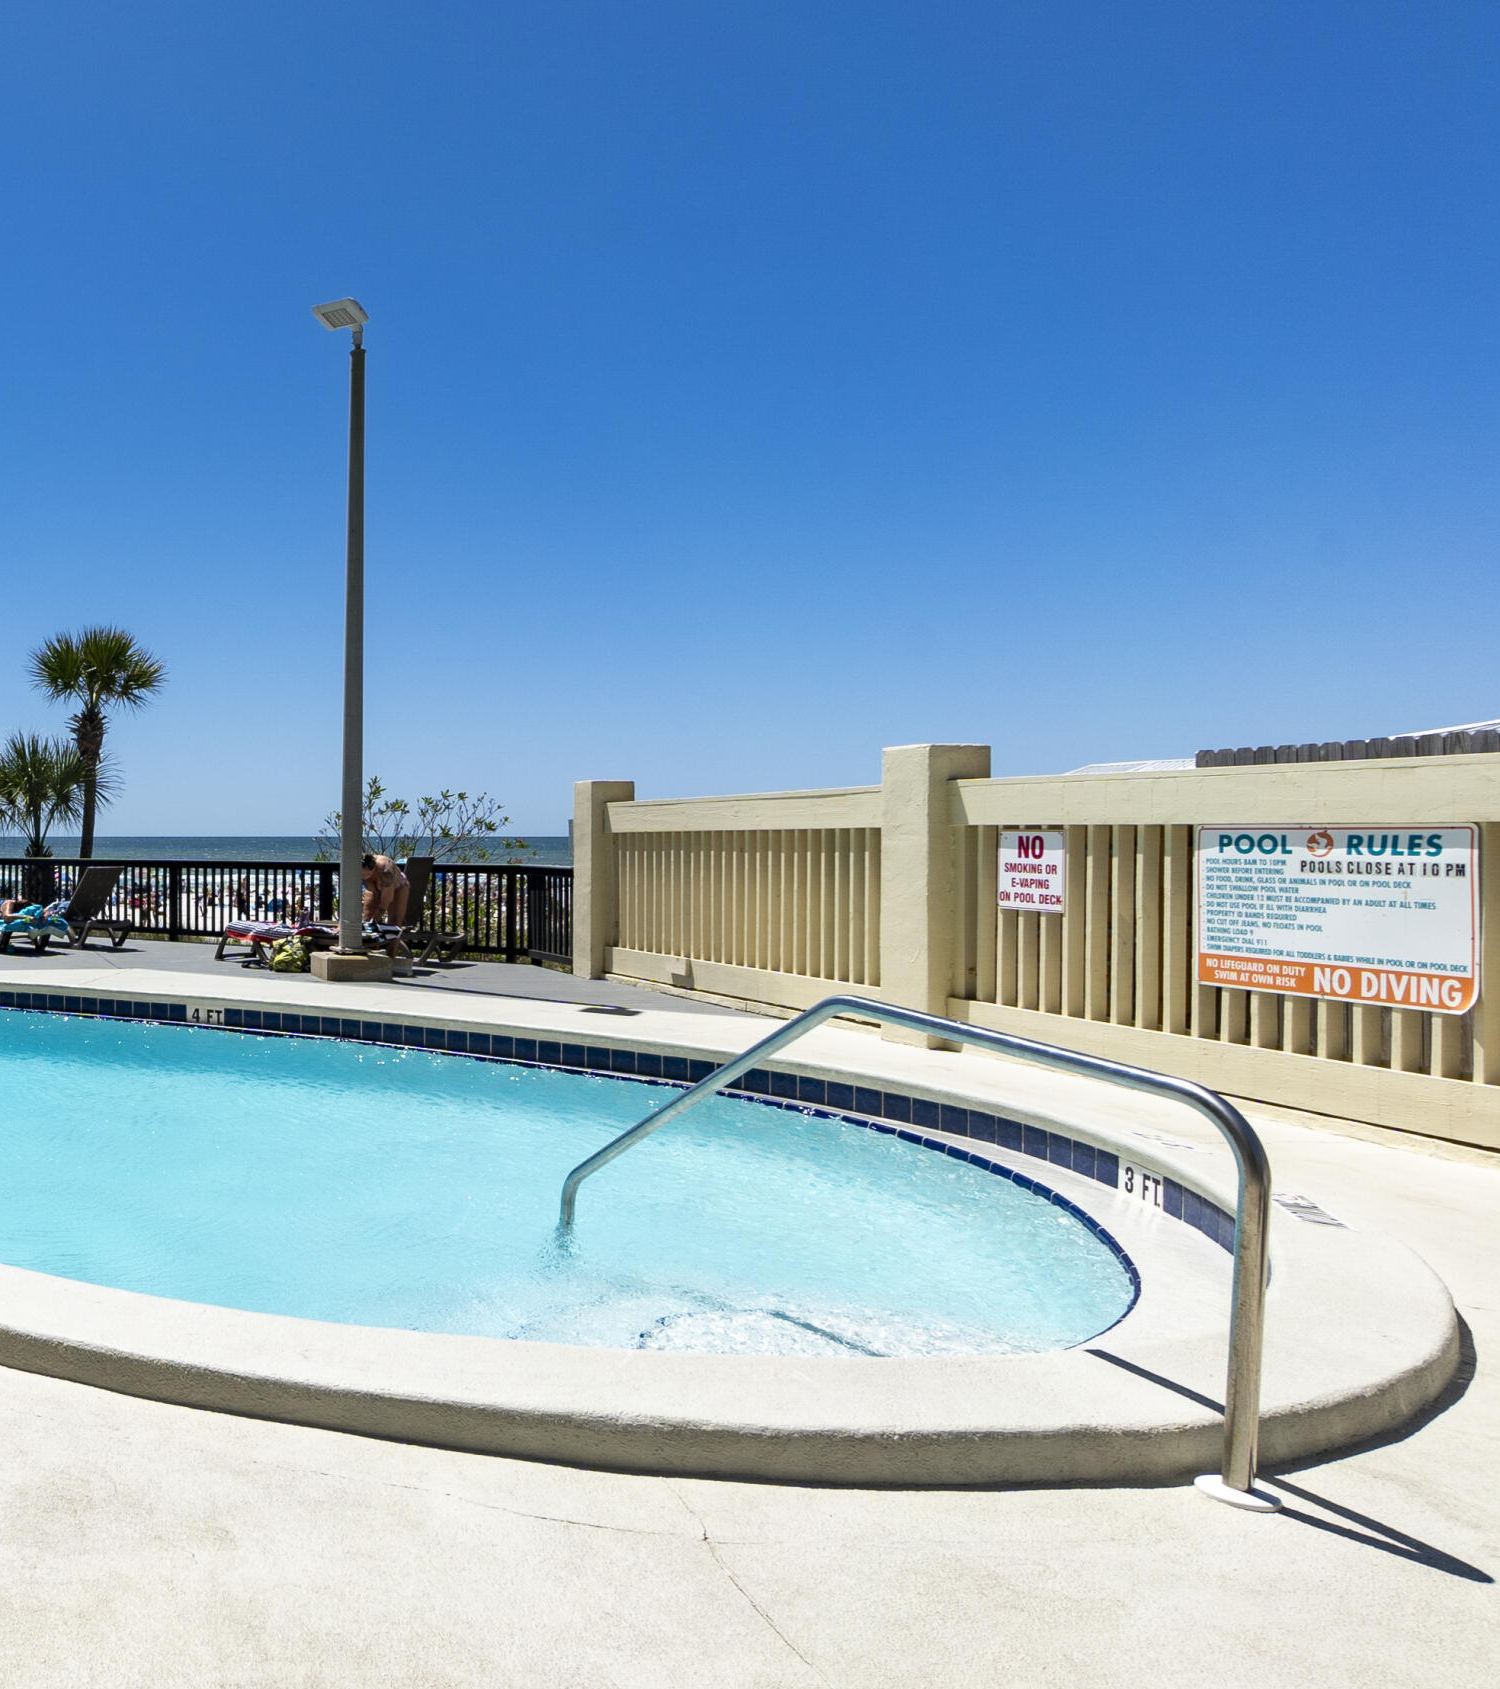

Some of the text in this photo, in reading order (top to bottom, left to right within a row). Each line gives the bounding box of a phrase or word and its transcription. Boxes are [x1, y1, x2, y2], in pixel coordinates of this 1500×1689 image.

[1018, 835, 1044, 859] NO
[1219, 834, 1443, 856] POOL RULES
[1004, 863, 1057, 875] SMOKING OR
[1300, 860, 1466, 877] POOLS CLOSE AT 10 PM
[1011, 877, 1049, 889] E-VAPING
[1229, 884, 1258, 892] SWALLOW
[1260, 885, 1276, 893] POOL
[1279, 886, 1299, 894] WATER
[1319, 878, 1326, 886] IN
[1328, 879, 1345, 887] POOL
[1371, 880, 1391, 888] POOL
[1393, 881, 1411, 889] DECK
[1000, 891, 1062, 905] ON POOL DECK
[1235, 893, 1254, 901] UNDER
[1285, 895, 1292, 903] BE
[1294, 896, 1340, 905] ACCOMPANIED
[1342, 898, 1350, 906] BY
[1365, 899, 1386, 908] ADULT
[1388, 900, 1397, 908] AT
[1399, 901, 1412, 909] ALL
[1414, 901, 1436, 910] TIMES
[1207, 909, 1235, 917] PROPERTY
[1245, 911, 1265, 919] BANDS
[1266, 912, 1297, 921] REQUIRED
[1242, 902, 1257, 910] POOL
[1295, 905, 1327, 914] DIARRHEA
[1207, 926, 1231, 935] BATHING
[1273, 922, 1295, 930] FLOATS
[1306, 924, 1323, 932] POOL
[1207, 935, 1240, 944] EMERGENCY
[1223, 944, 1244, 953] DIAPERS
[1245, 946, 1272, 955] REQUIRED
[1297, 951, 1326, 960] TODDLERS
[1333, 954, 1354, 962] BABIES
[1355, 956, 1375, 964] WHILE
[1377, 957, 1384, 965] IN
[1386, 958, 1403, 967] POOL
[1405, 960, 1416, 968] OR
[1417, 961, 1428, 969] ON
[1429, 962, 1448, 971] POOL
[1450, 964, 1468, 973] DECK
[1206, 958, 1306, 977] NO LIFEGUARD ON DUTY
[1214, 970, 1296, 988] SWIM AT OWN RISK
[1313, 966, 1462, 1008] NO DIVING
[192, 1008, 200, 1023] 4
[1125, 1166, 1134, 1193] 3
